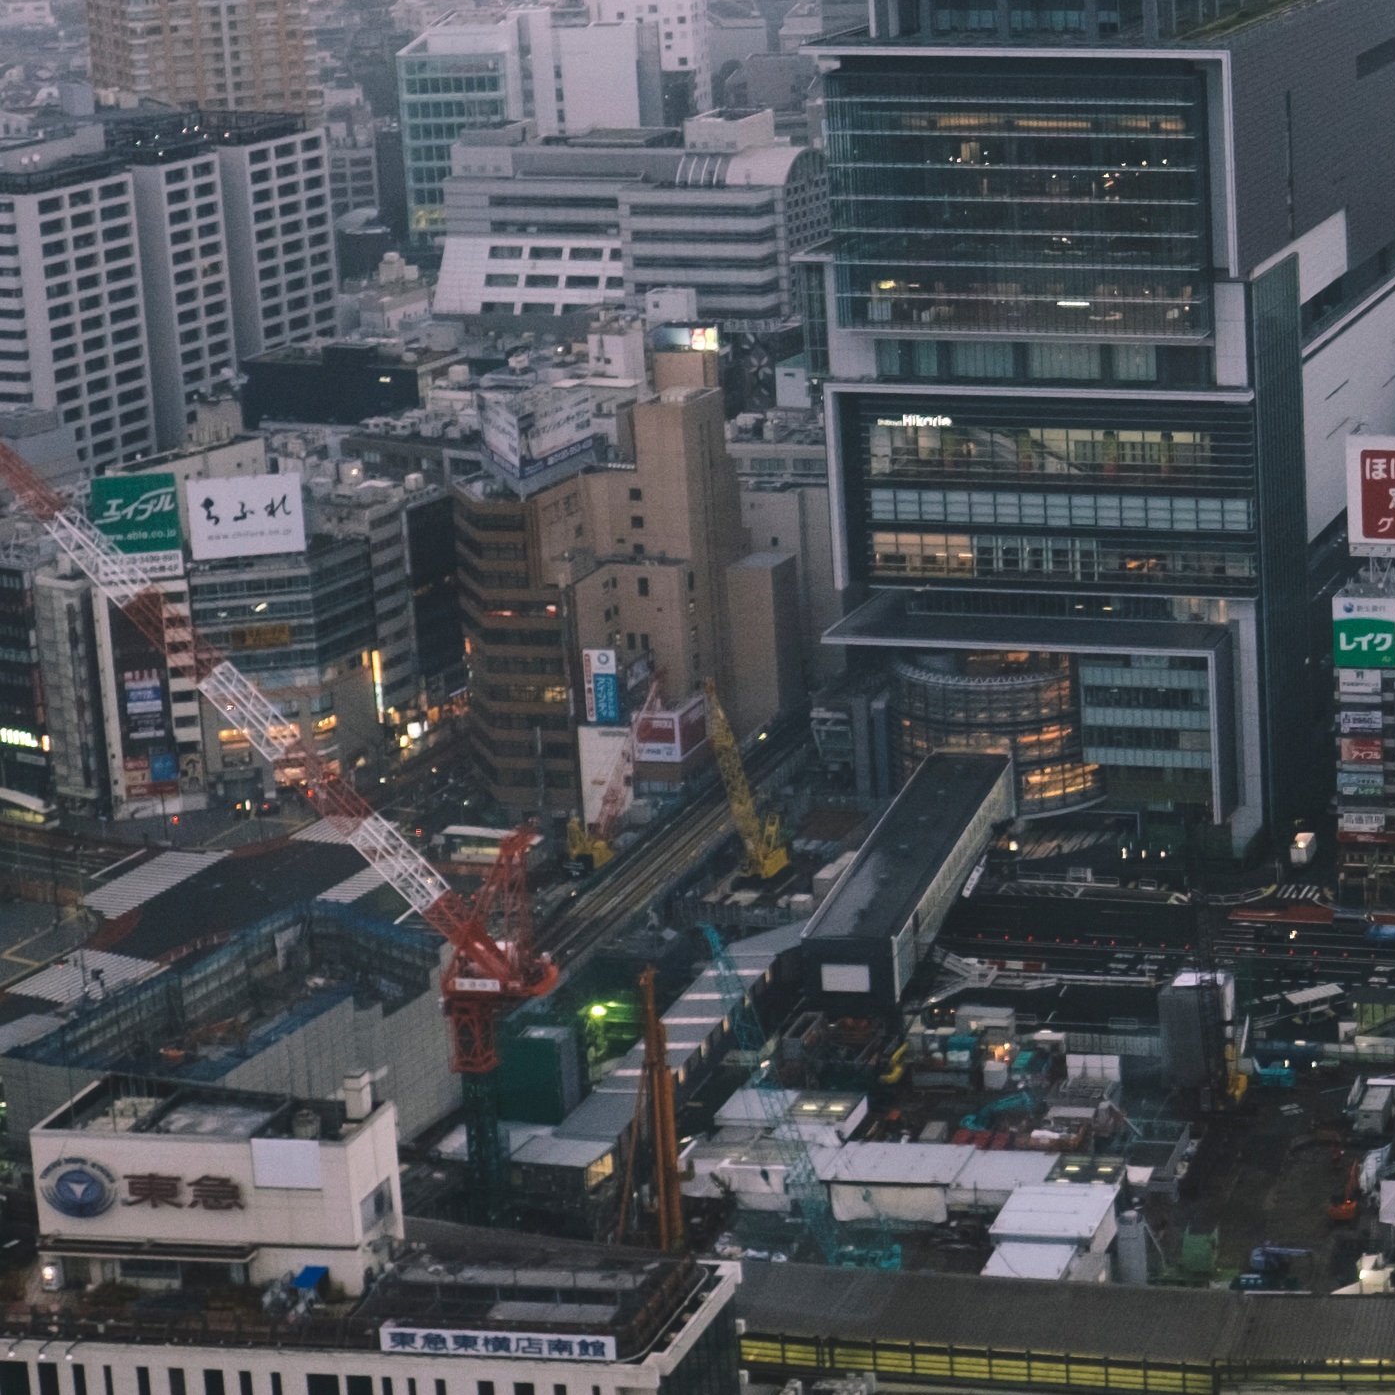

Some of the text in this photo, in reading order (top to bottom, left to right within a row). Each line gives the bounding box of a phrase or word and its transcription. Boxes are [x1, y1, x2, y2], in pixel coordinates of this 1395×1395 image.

[94, 486, 176, 525] エイブル
[200, 494, 292, 526] ちふれ
[1339, 631, 1394, 652] レイク
[122, 1173, 245, 1210] 東急
[389, 1330, 606, 1358] 東急東横店南館
